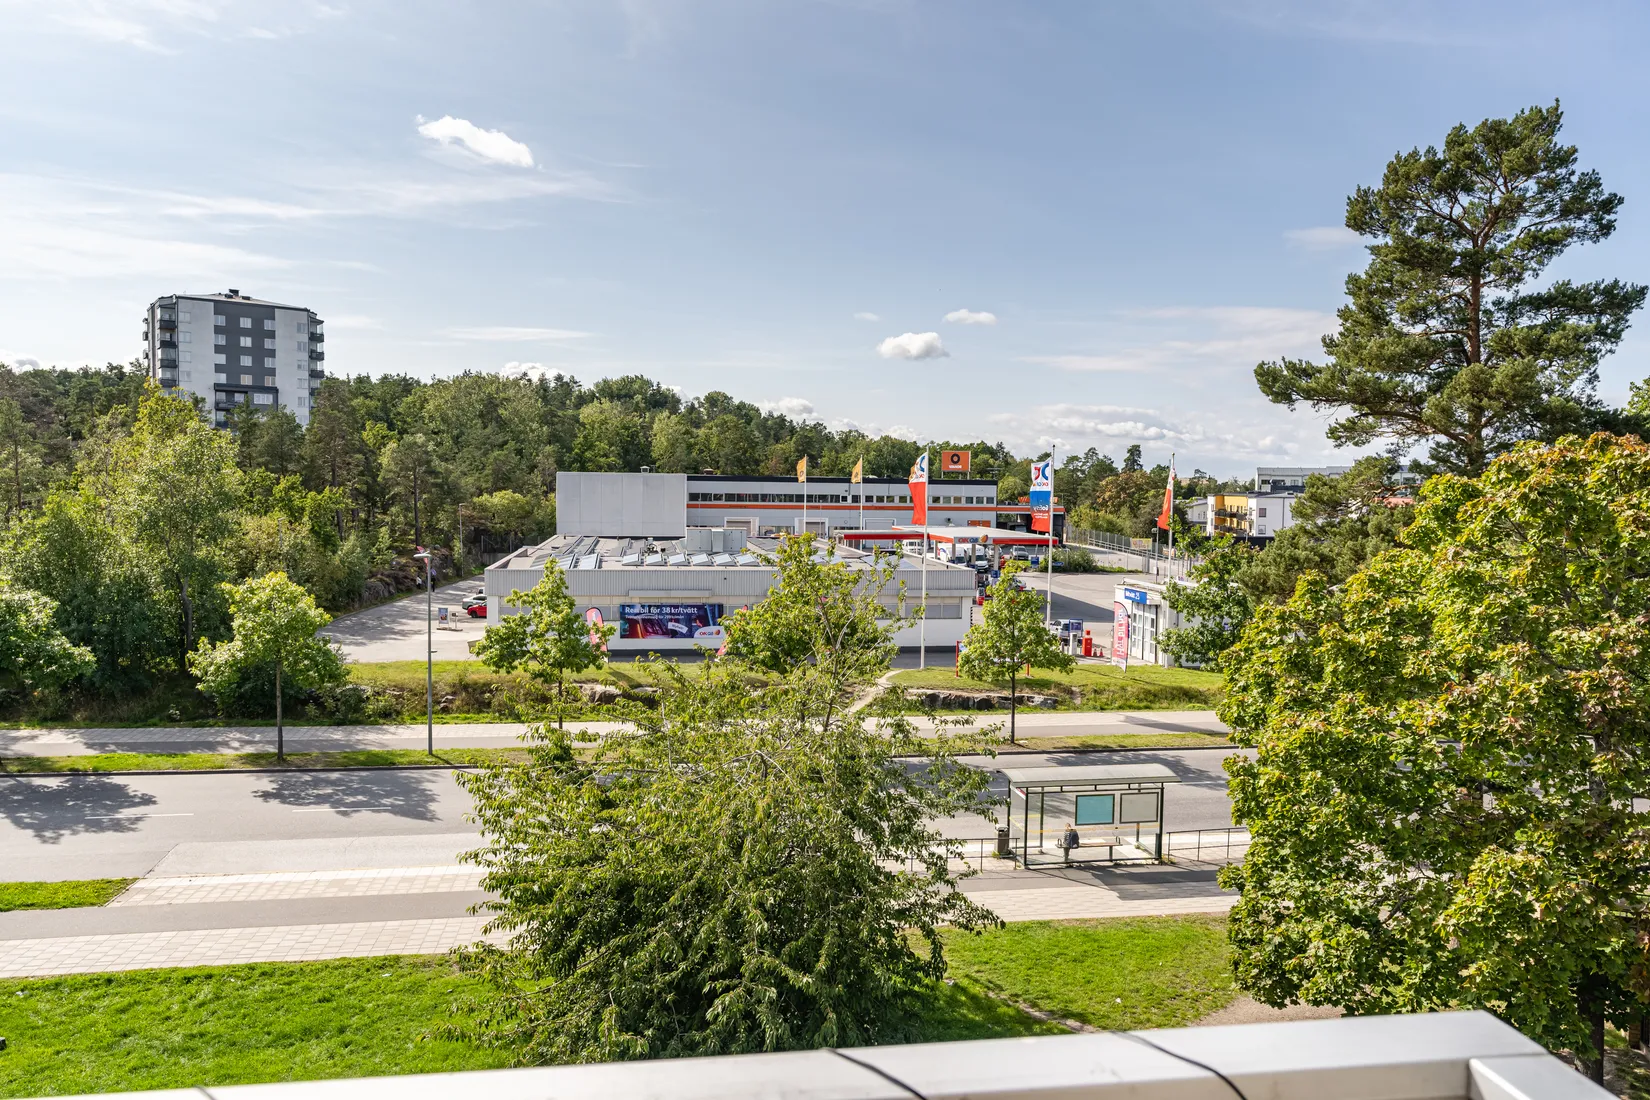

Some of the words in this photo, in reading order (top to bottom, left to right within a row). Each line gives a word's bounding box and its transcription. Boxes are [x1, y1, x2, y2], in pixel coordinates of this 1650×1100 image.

[640, 606, 649, 614] bil
[650, 606, 661, 614] för
[661, 606, 671, 614] 38
[671, 606, 698, 614] kr/tvätt
